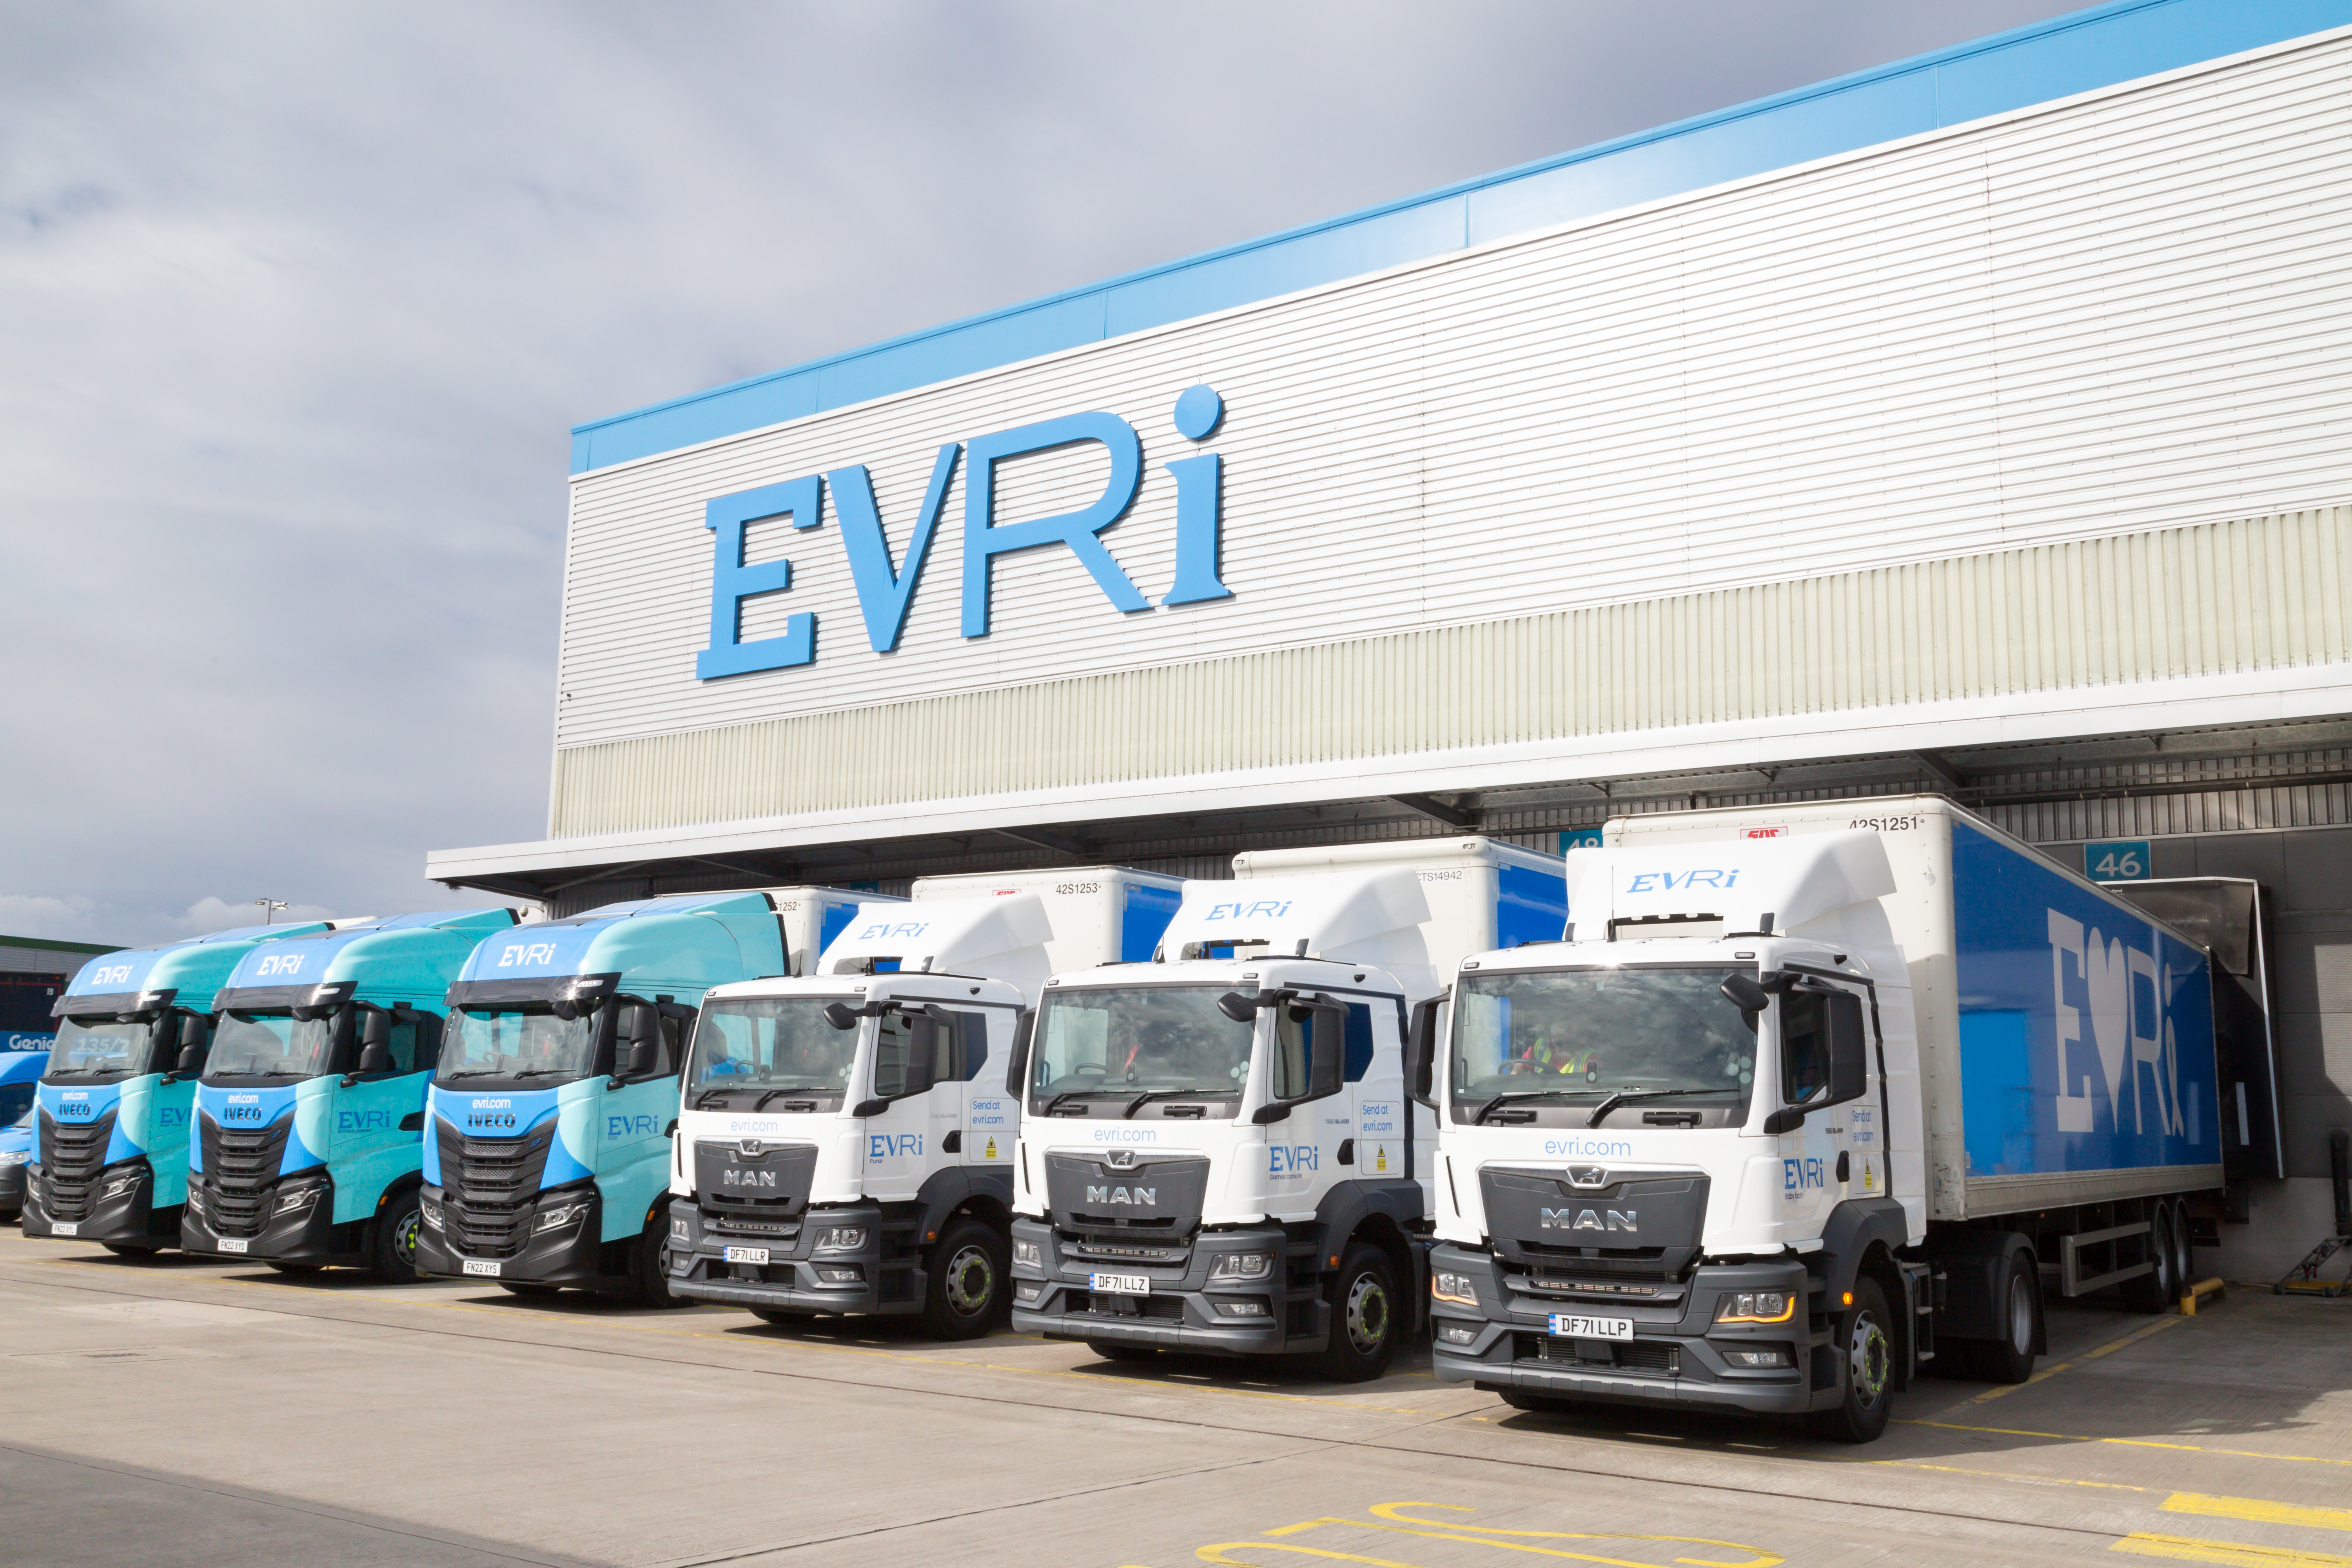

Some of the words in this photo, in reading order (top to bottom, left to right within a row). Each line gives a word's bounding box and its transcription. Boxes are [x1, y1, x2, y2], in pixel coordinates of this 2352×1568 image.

[696, 383, 1233, 681] EVRi
[2095, 851, 2140, 877] 46
[1056, 883, 1097, 894] 42S1253
[1626, 869, 1739, 893] EVRi
[1204, 901, 1292, 920] EVRi
[858, 923, 929, 940] EVRi
[498, 943, 556, 967] EVRi
[257, 955, 305, 975] EVRi
[91, 965, 133, 985] EVRi
[63, 1091, 88, 1100] evri.com
[229, 1093, 258, 1103] evri.com
[472, 1096, 511, 1109] evri.com
[59, 1103, 91, 1116] IVECO
[973, 1100, 991, 1109] Send
[993, 1101, 1000, 1109] at
[1363, 1104, 1379, 1114] Send
[1381, 1105, 1388, 1114] at
[224, 1107, 261, 1120] IVECO
[338, 1111, 390, 1129] EVRi
[468, 1113, 516, 1128] IVECO
[973, 1114, 1004, 1123] evri.com
[1852, 1110, 1865, 1122] Send
[1866, 1111, 1871, 1122] at
[608, 1115, 658, 1136] EVRi
[731, 1119, 777, 1131] evri.com
[1363, 1120, 1392, 1131] evri.com
[1095, 1127, 1156, 1141] evri.com
[1853, 1129, 1873, 1142] evri.com
[870, 1134, 923, 1157] EVRi
[1545, 1137, 1630, 1156] evri.com
[1270, 1146, 1318, 1171] EVRi
[724, 1170, 776, 1186] MAN
[1784, 1158, 1824, 1189] EVRi
[1087, 1186, 1156, 1205] MAN
[1541, 1208, 1637, 1231] MAN
[221, 1241, 234, 1249] FN22
[731, 1249, 748, 1260] DF71
[750, 1250, 765, 1261] LLR
[467, 1263, 483, 1272] FN22
[485, 1264, 497, 1273] XYS
[1099, 1276, 1121, 1289] DF71
[1125, 1278, 1145, 1290] LLZ
[1562, 1318, 1593, 1334] DF71
[1599, 1321, 1626, 1336] LLP
